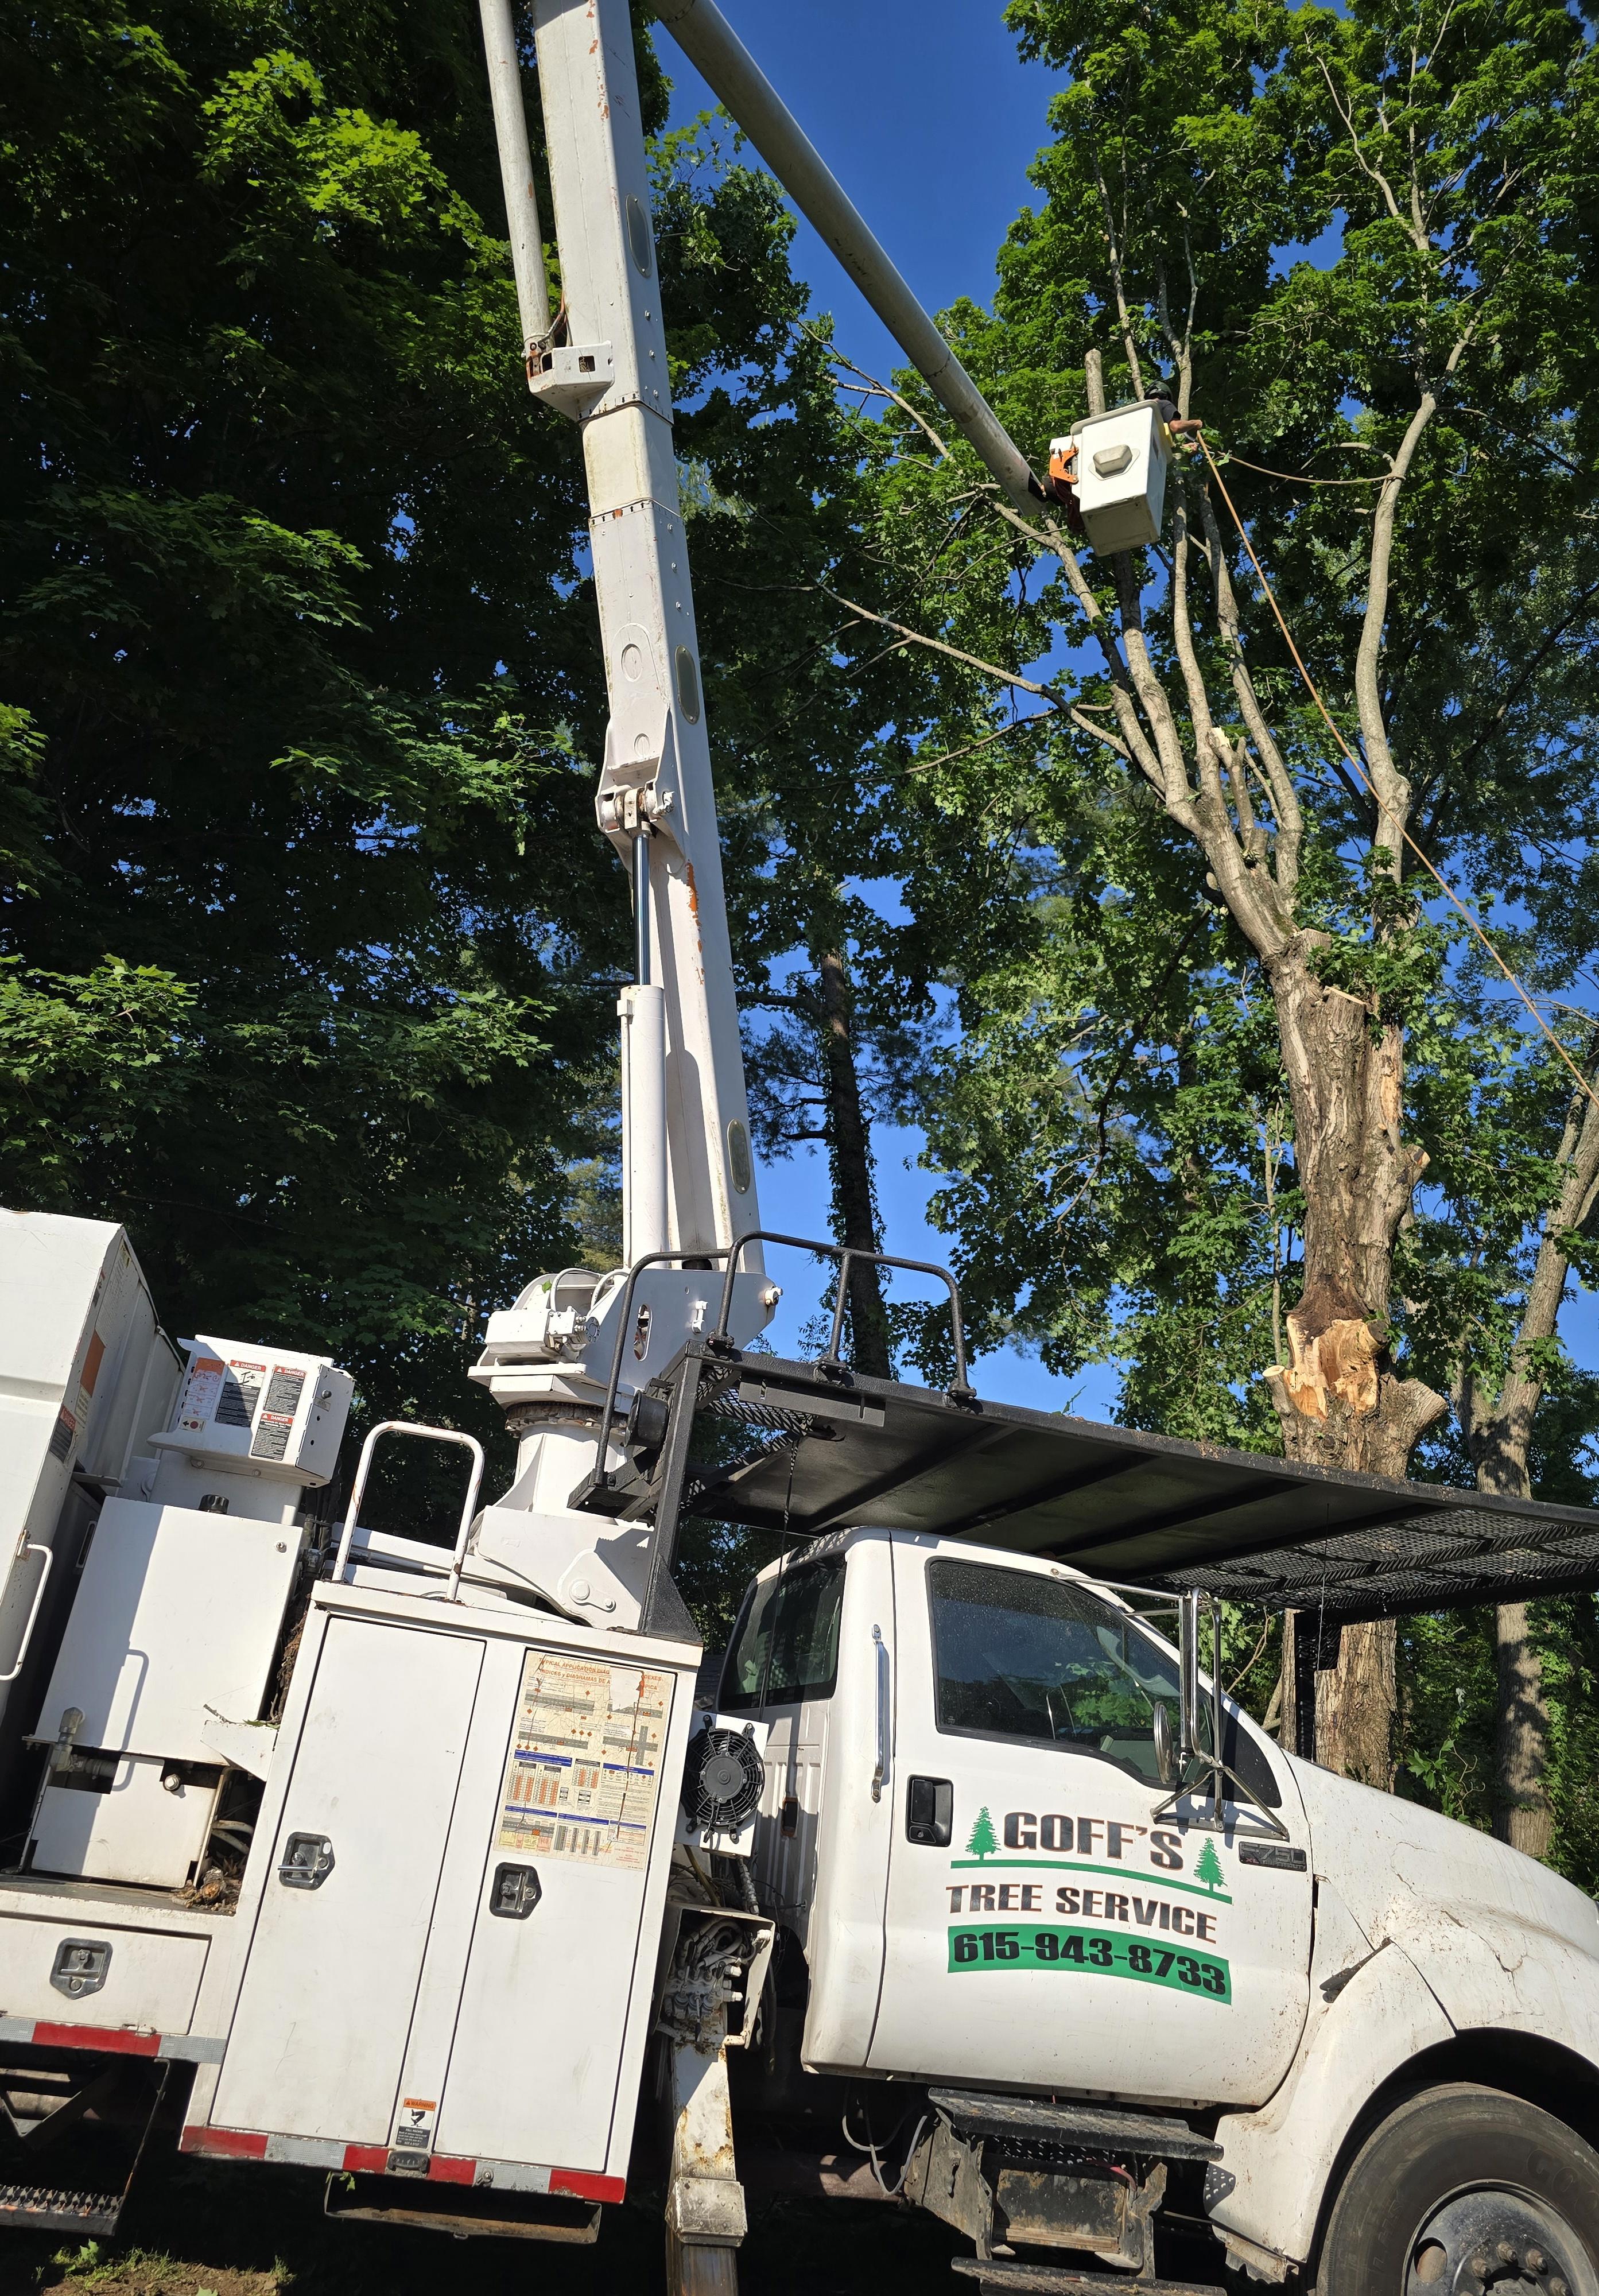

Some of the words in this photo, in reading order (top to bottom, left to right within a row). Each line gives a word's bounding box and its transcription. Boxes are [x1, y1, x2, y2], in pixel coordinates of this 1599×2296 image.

[562, 1663, 596, 1672] APPLICATION
[566, 1673, 597, 1682] DIAGRAMAS
[1003, 1812, 1183, 1871] GOFF'S
[946, 1883, 1043, 1914] TREE
[1055, 1886, 1217, 1944] SERVICE
[953, 1932, 1226, 1995] 615-943-8733
